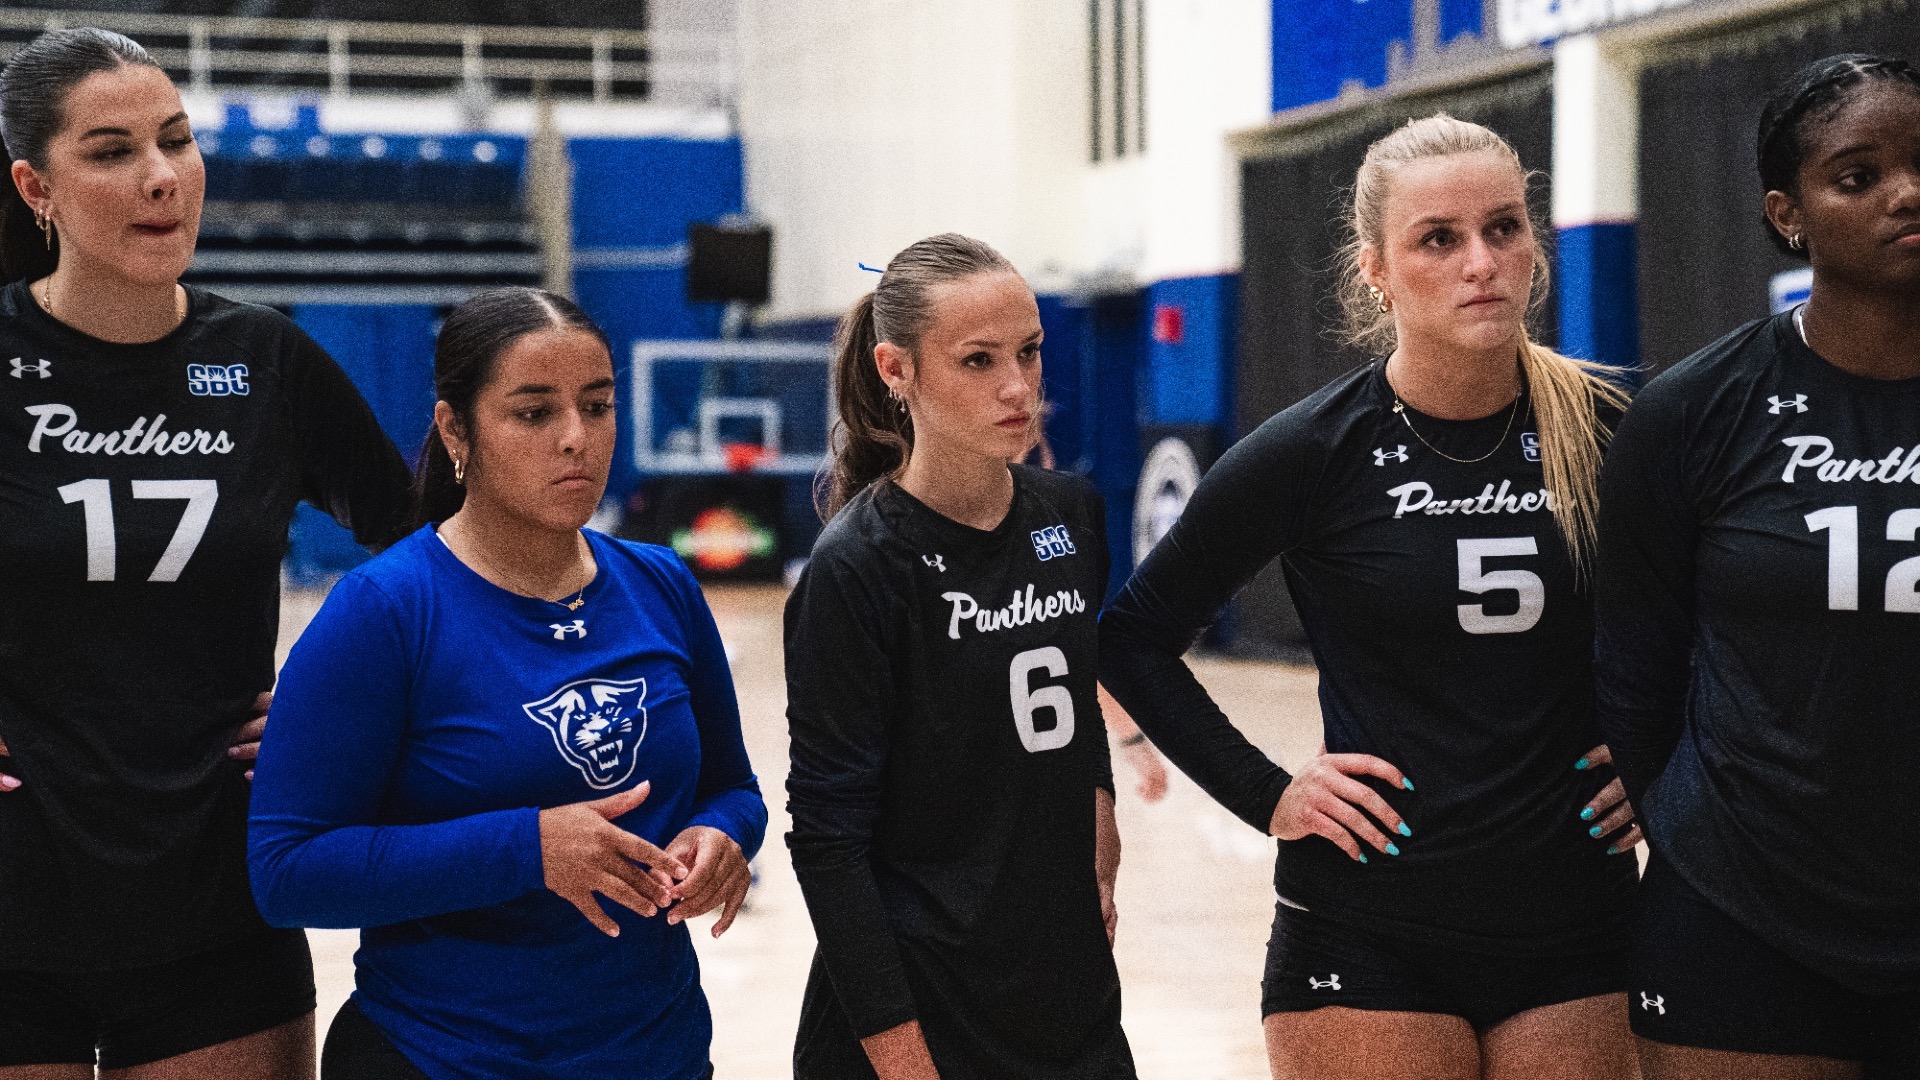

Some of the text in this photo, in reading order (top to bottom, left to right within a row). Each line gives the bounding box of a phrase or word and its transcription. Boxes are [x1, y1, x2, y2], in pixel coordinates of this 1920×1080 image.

[187, 363, 249, 396] SBC
[24, 403, 235, 456] Panthers
[1781, 435, 1920, 485] Panth
[1386, 479, 1576, 518] Panther
[57, 478, 219, 581] 17
[1031, 525, 1076, 562] SBC
[941, 583, 1086, 640] Panthers
[1456, 536, 1546, 635] 5
[1009, 646, 1075, 753] 6
